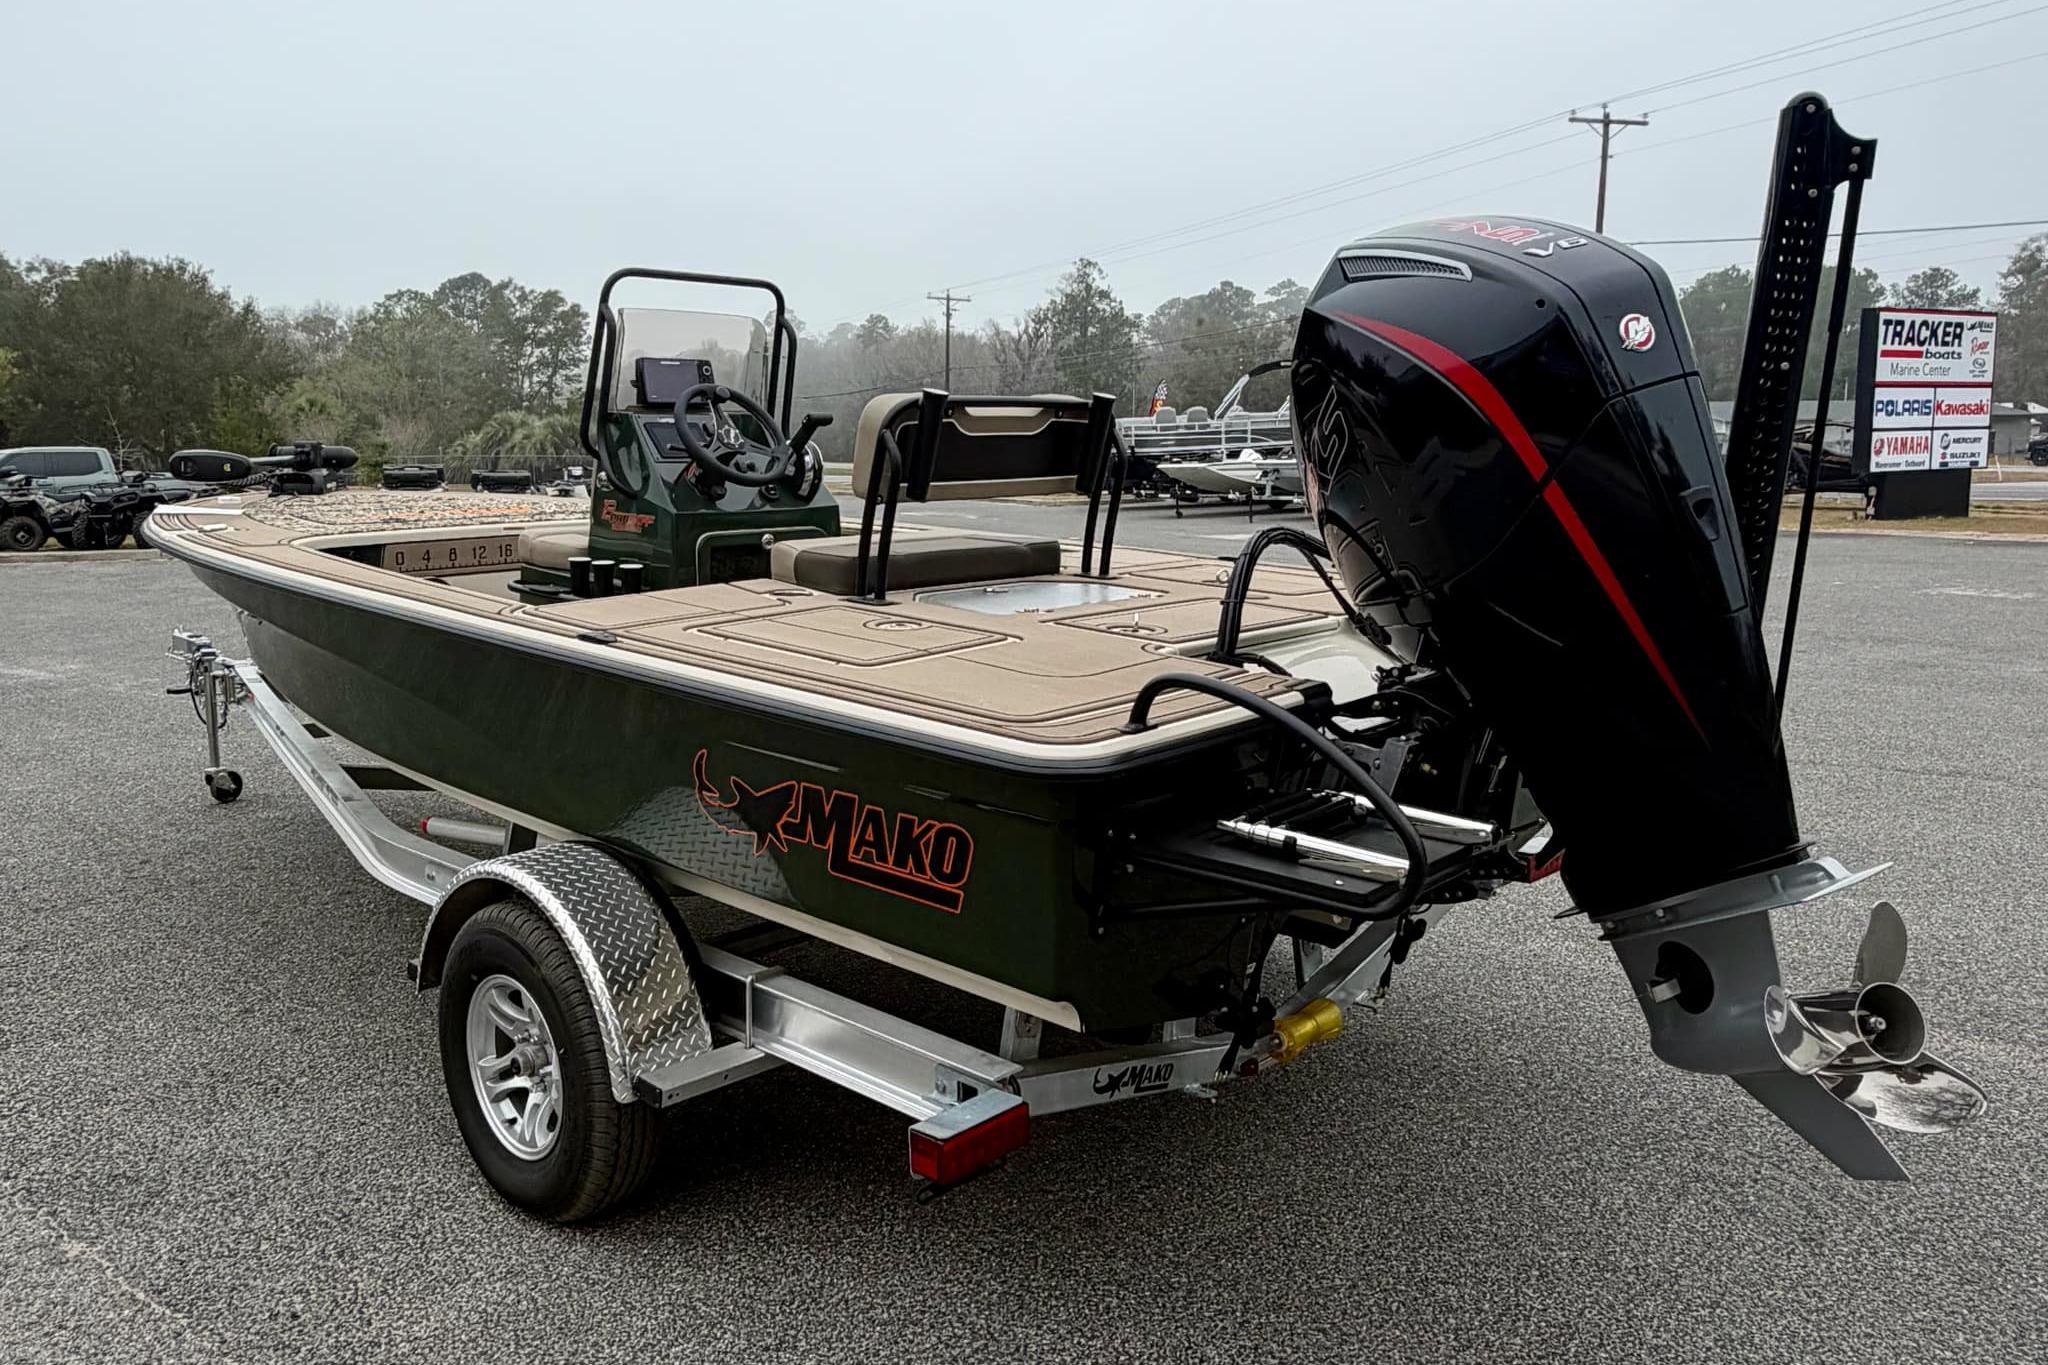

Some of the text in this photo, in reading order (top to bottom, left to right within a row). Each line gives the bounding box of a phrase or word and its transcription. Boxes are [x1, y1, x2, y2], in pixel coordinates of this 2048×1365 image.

[1522, 236, 1588, 258] V6
[1882, 318, 1965, 348] TRACKER
[1924, 348, 1963, 360] boats
[1890, 362, 1951, 377] Marine Center
[1875, 399, 1932, 417] POLARIS
[1935, 399, 1990, 416] Kawasaki
[1886, 436, 1929, 456] YAMAHA
[1952, 437, 1983, 445] MERCURY
[1950, 452, 1981, 460] SUZUKI
[422, 549, 432, 563] 4
[449, 548, 457, 562] 8
[473, 546, 487, 560] 12
[498, 543, 513, 558] 16
[780, 782, 974, 914] MAKO
[1121, 1063, 1174, 1094] MAKO
